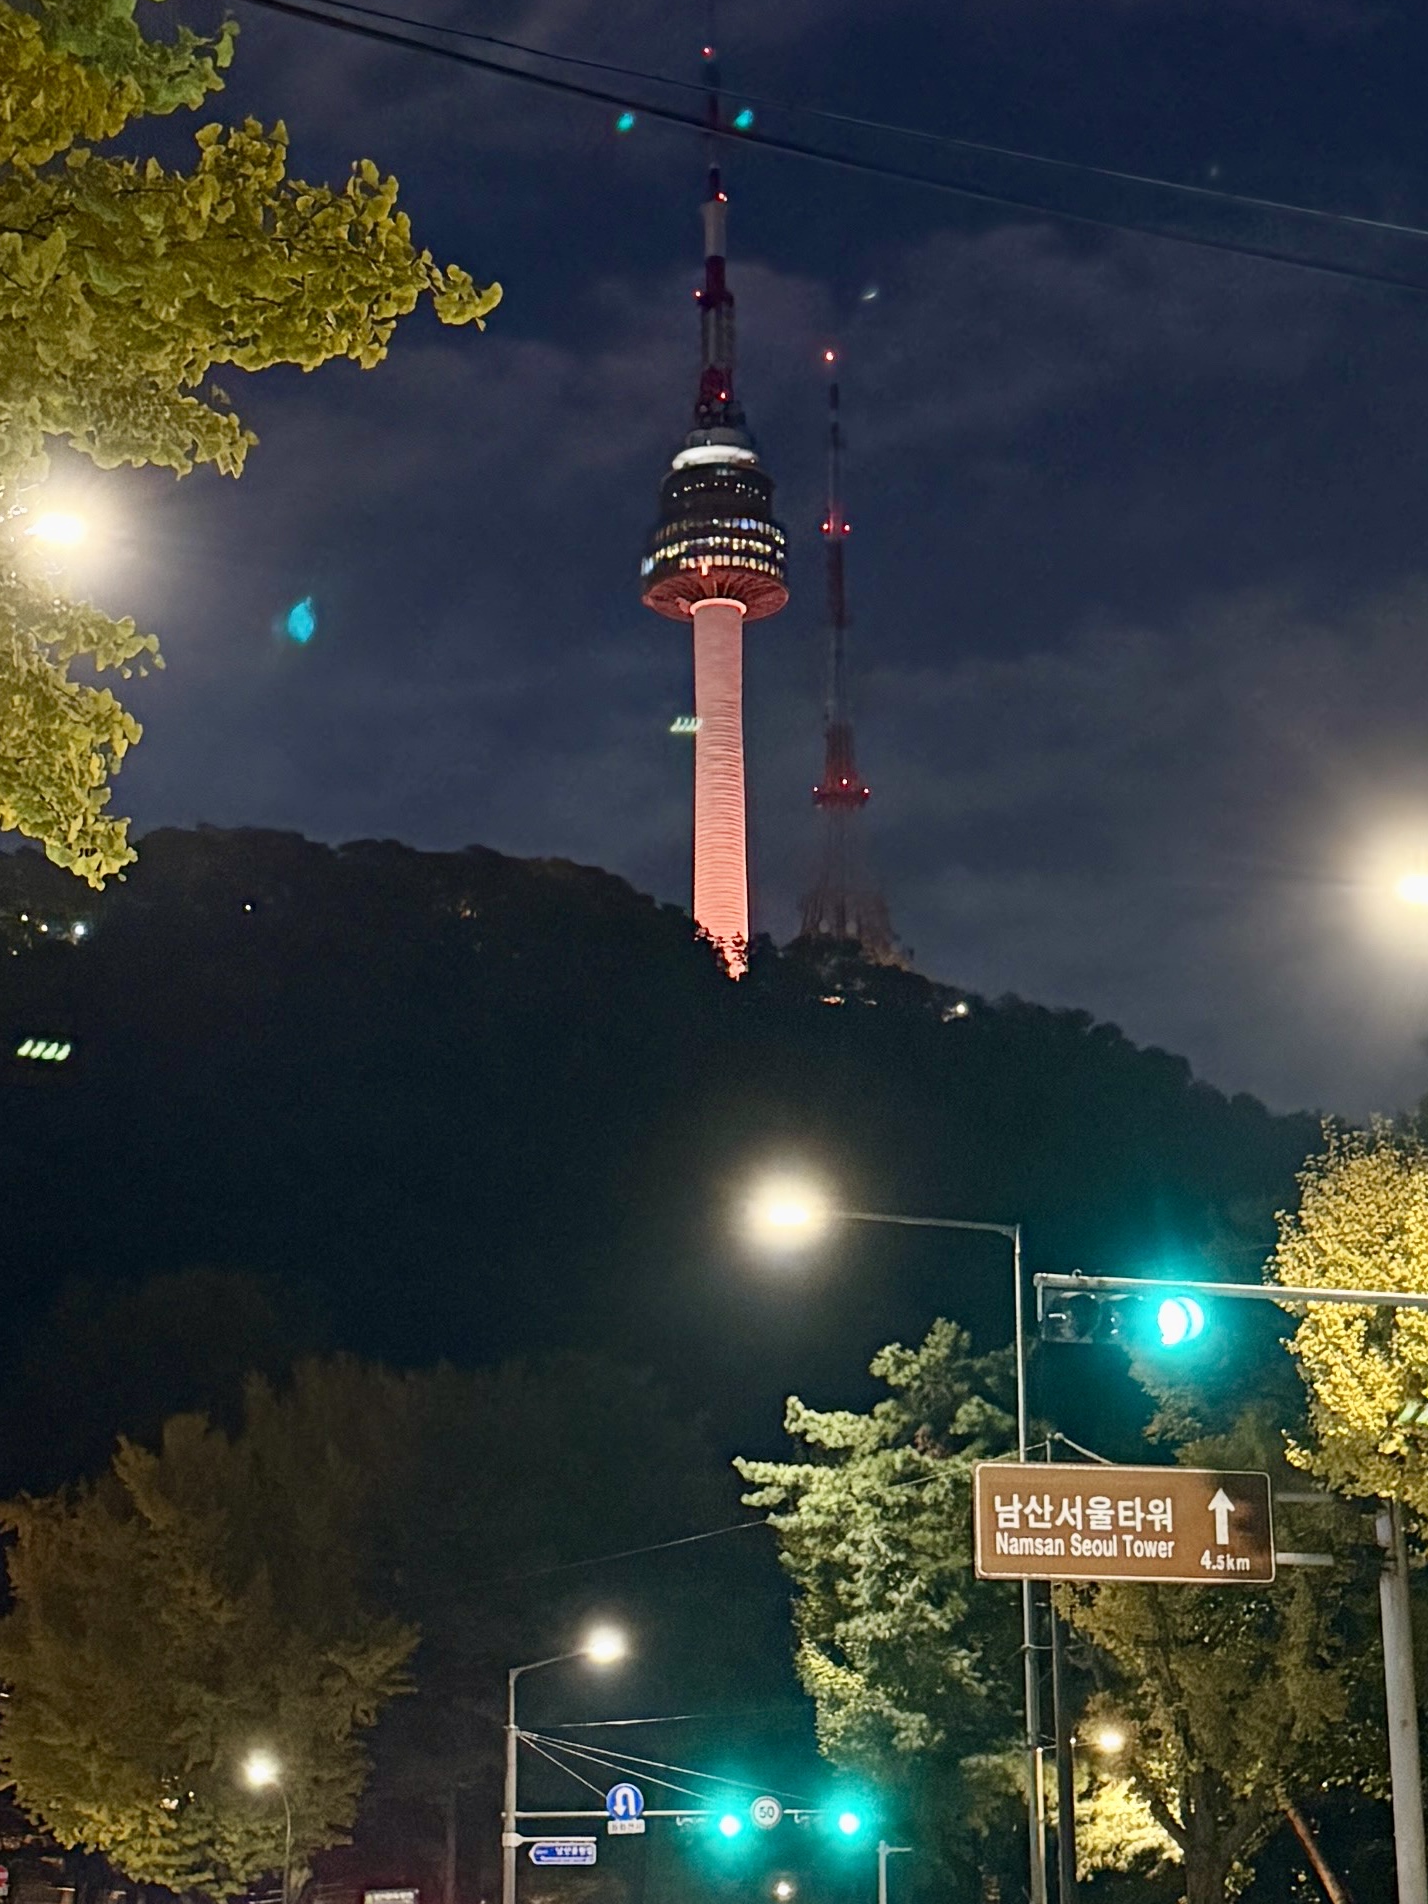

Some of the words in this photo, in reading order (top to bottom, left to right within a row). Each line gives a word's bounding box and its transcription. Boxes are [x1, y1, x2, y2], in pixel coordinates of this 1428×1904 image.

[993, 1493, 1174, 1533] 남산서울타워
[996, 1532, 1065, 1556] Namsan
[1070, 1534, 1118, 1558] Seoul
[1122, 1535, 1175, 1559] Tower
[1200, 1549, 1251, 1572] 4.5km
[759, 1805, 776, 1819] 50
